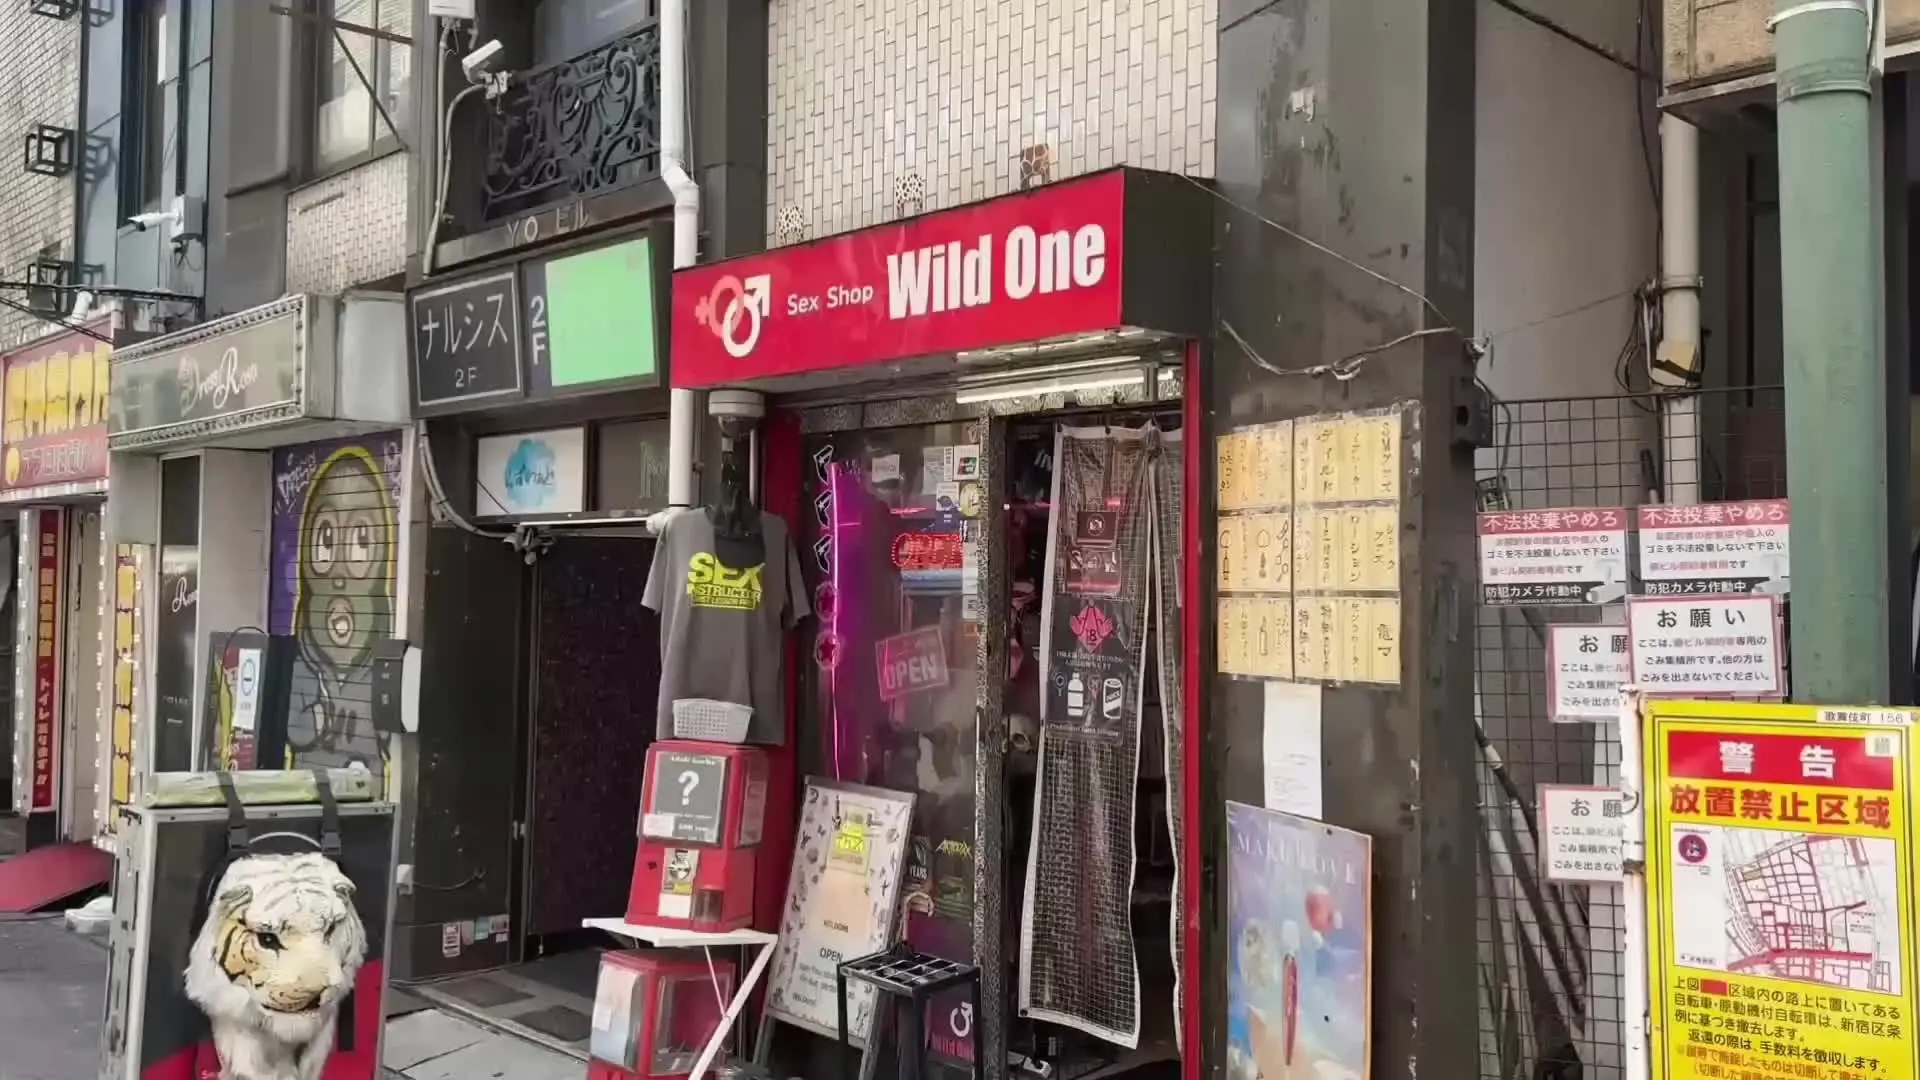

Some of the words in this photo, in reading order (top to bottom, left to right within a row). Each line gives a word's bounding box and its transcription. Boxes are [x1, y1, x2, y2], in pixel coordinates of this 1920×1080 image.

[506, 216, 540, 245] YO
[786, 292, 819, 316] Sex
[827, 282, 874, 309] Shop
[887, 233, 992, 320] Wild
[1004, 223, 1106, 301] One
[421, 292, 508, 360] ナルシス
[454, 366, 479, 388] 2F
[1483, 511, 1618, 531] 不法投棄やめろ
[1643, 503, 1785, 526] 不法投棄やめろ
[1487, 546, 1620, 559] ゴミを不法投棄しないで下さい
[1646, 541, 1785, 554] ゴミを不法投棄しないで下さい
[1485, 585, 1582, 598] 防犯カメラ作動中
[1645, 580, 1747, 594] 防犯カメラ作動中
[1657, 608, 1746, 628] お願い
[883, 651, 938, 691] OPEN
[1645, 653, 1764, 666] ごみ集積所です。他の方は
[1640, 671, 1769, 683] ごみを出さないでください。
[1719, 741, 1836, 779] 警告
[1669, 784, 1893, 830] 放置禁止区域
[819, 946, 844, 963] OPEN
[1728, 982, 1902, 1020] 区域内の路上に置いてある
[1674, 993, 1903, 1040] 自転車・原動機付自転車は、新宿区条
[1675, 1010, 1806, 1042] 例に基づき撤去します。
[1687, 1028, 1888, 1073] 返還の際は、手数料を徴収します。
